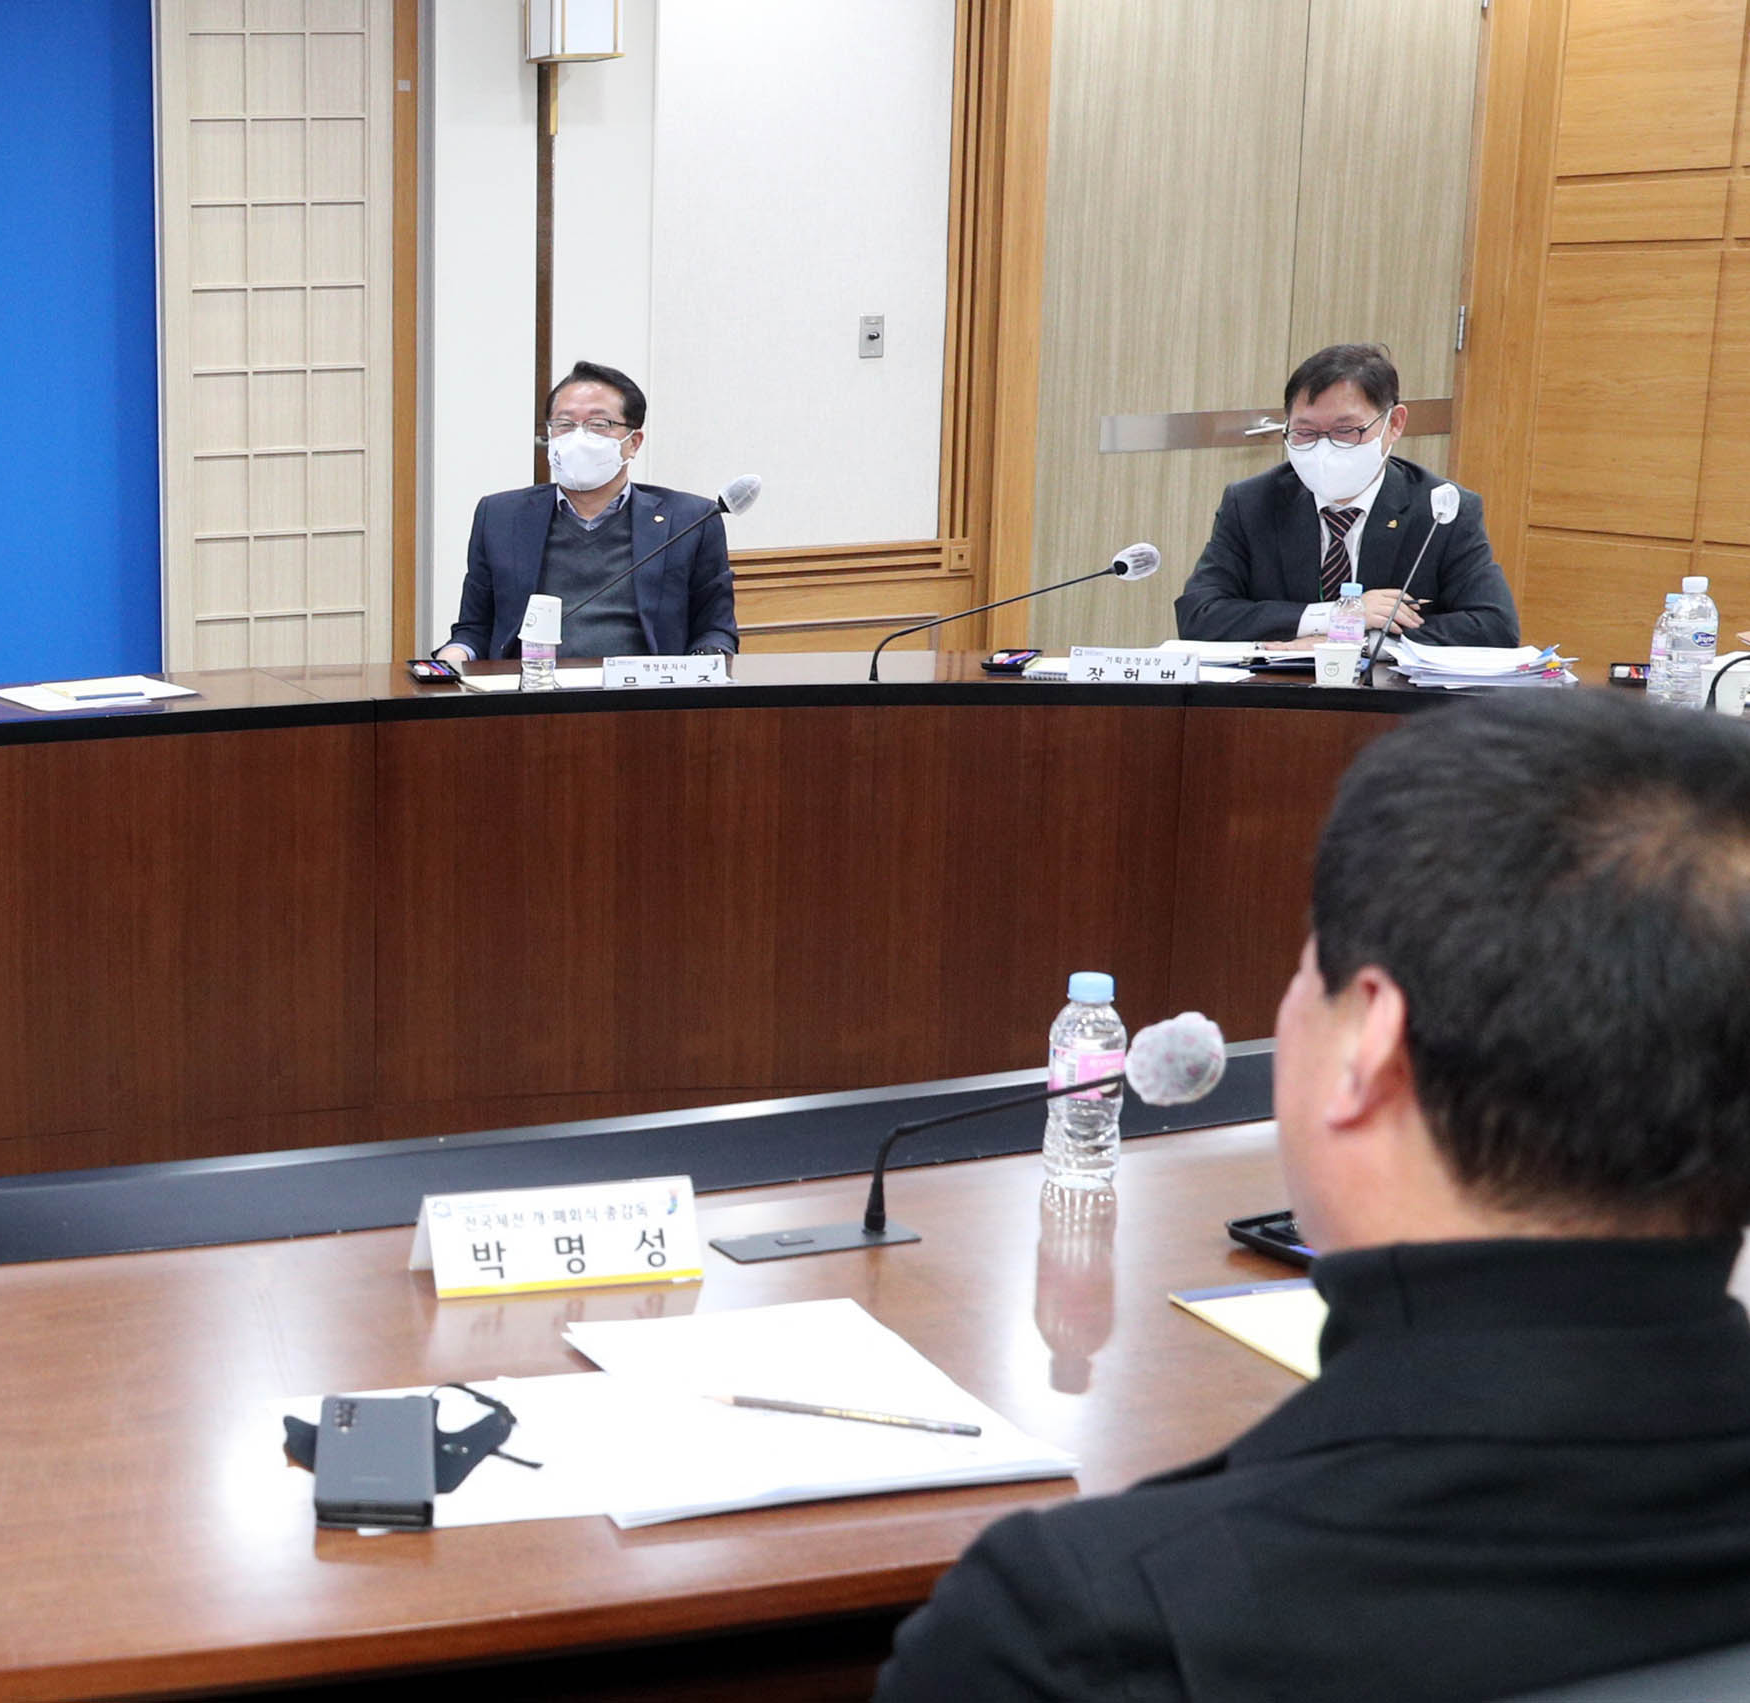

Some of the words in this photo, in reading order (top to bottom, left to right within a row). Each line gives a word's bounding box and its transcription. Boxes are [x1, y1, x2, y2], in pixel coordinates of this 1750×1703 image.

[472, 1240, 507, 1280] 박
[554, 1233, 586, 1275] 명
[635, 1227, 667, 1268] 성
